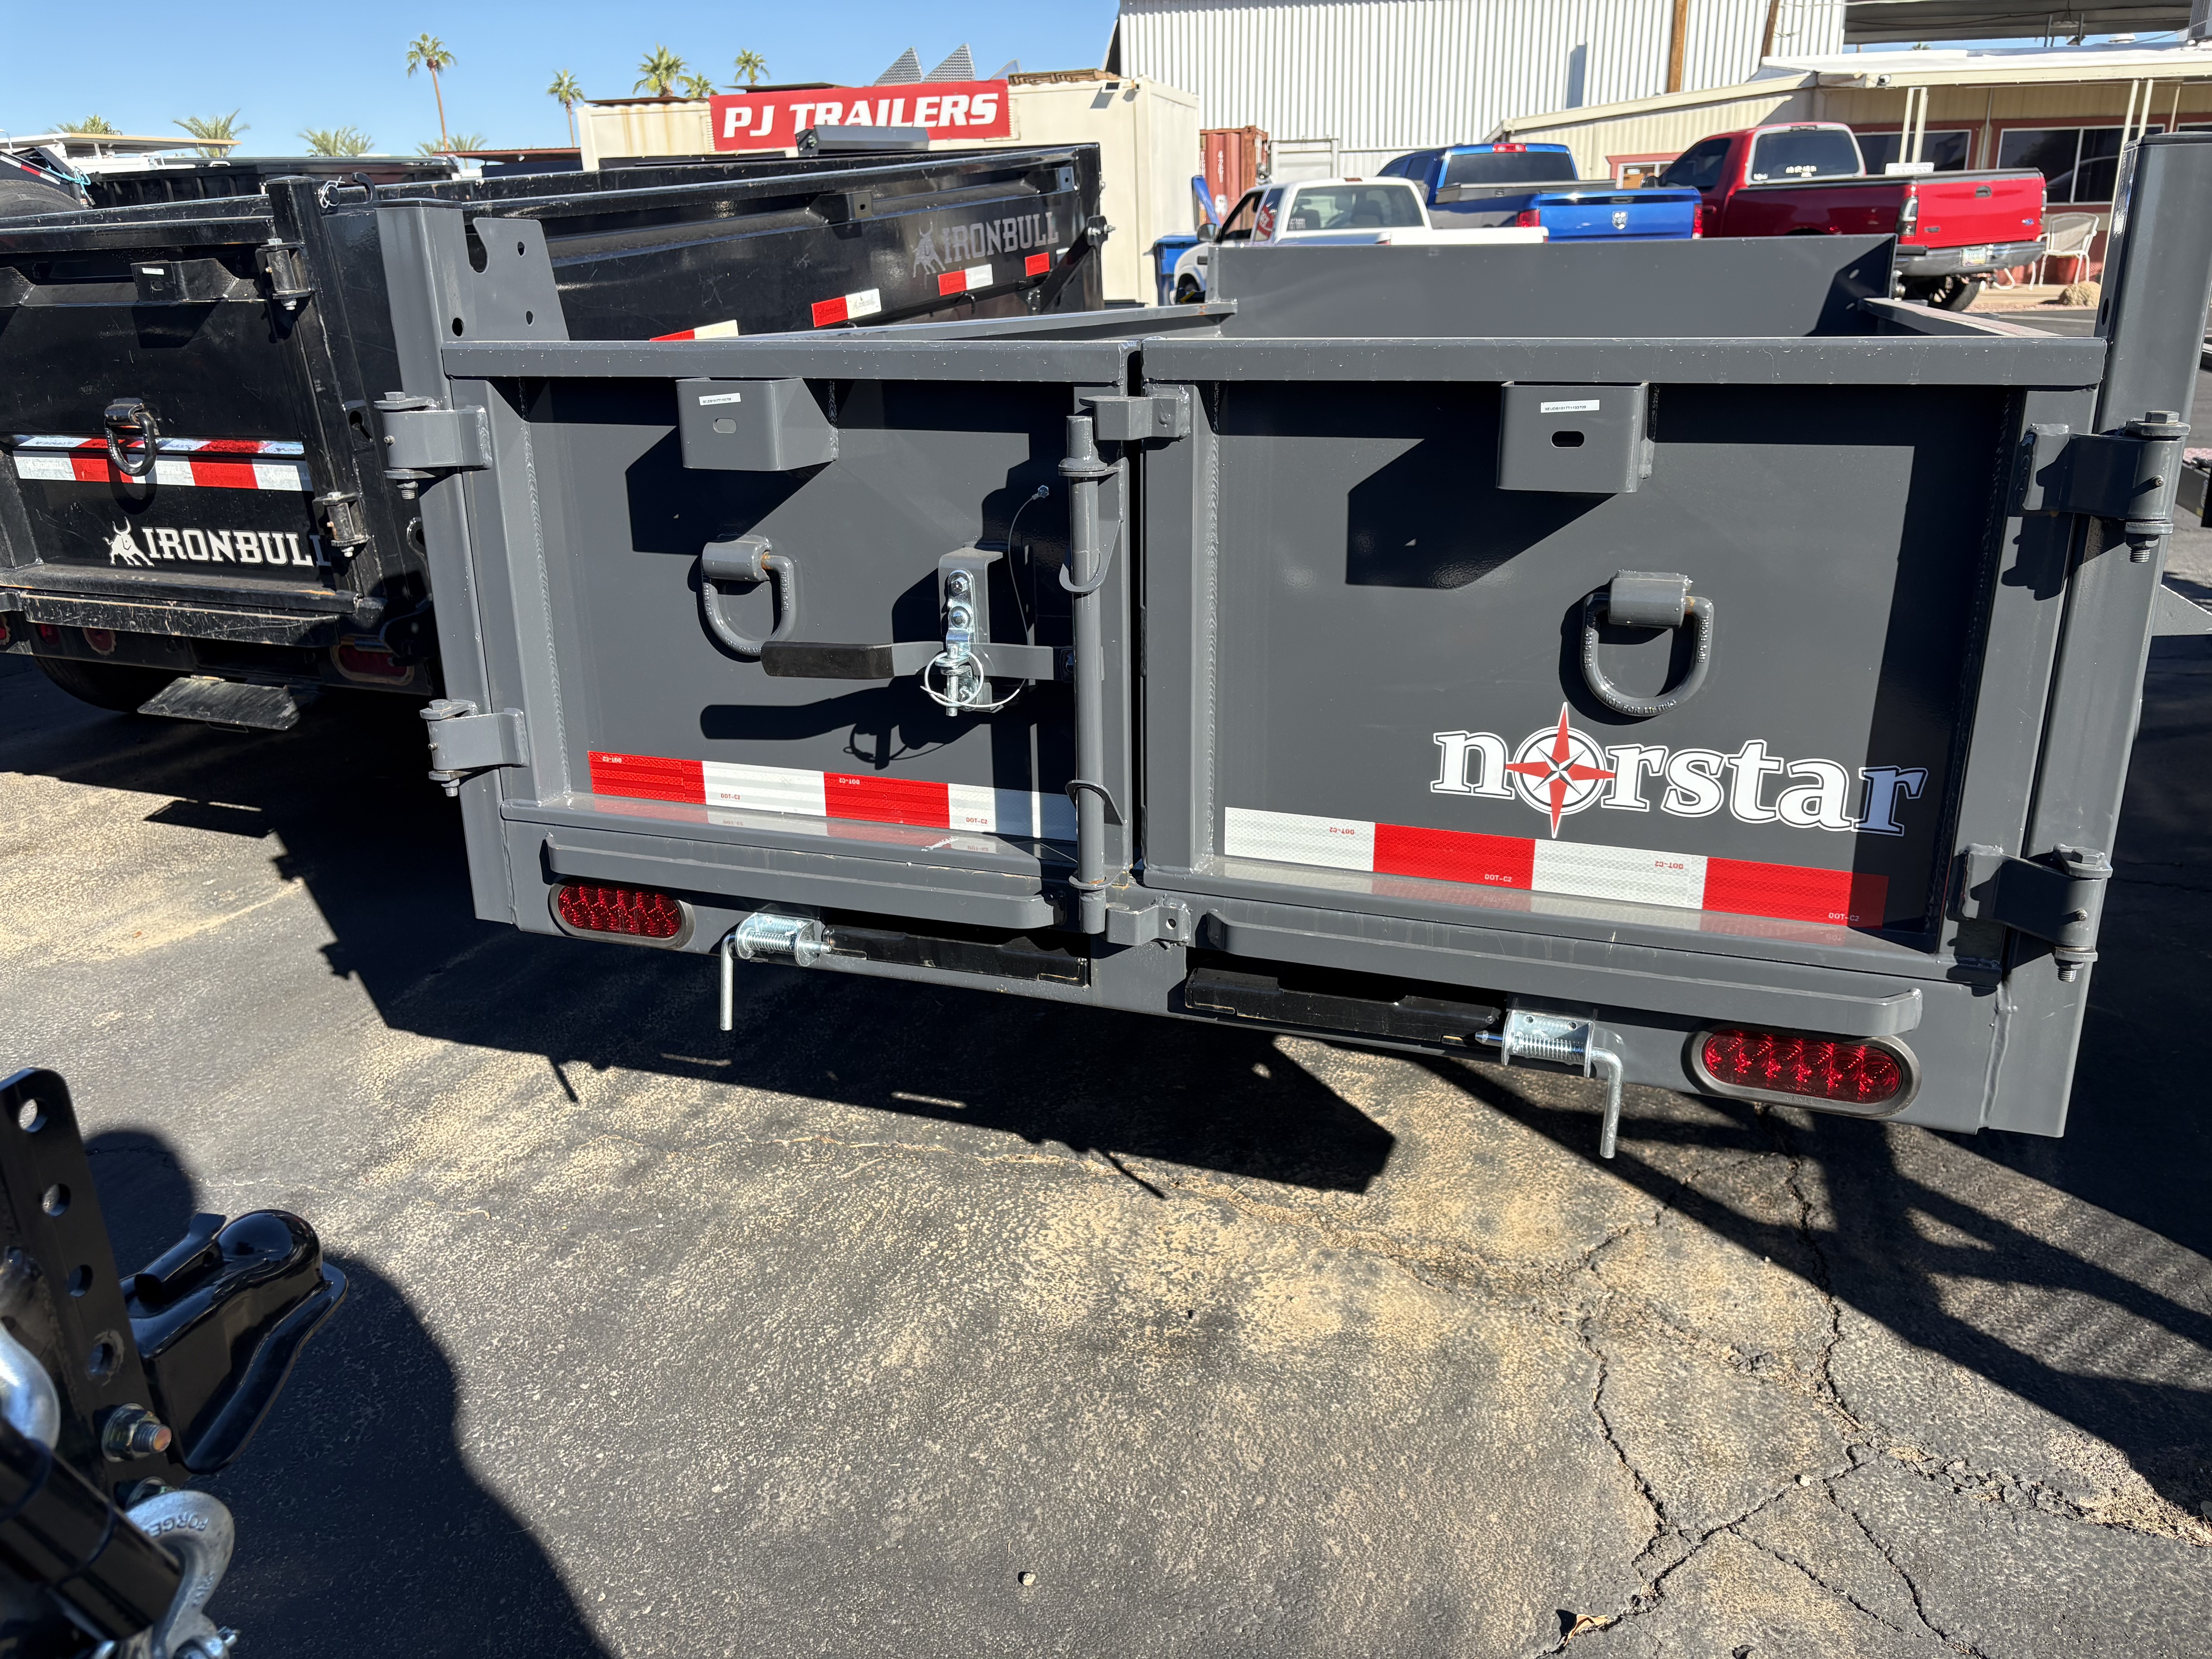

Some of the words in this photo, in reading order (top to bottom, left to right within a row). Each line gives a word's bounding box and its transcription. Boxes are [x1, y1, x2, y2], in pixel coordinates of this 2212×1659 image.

[723, 105, 775, 138] PJ
[789, 93, 999, 134] TRAILERS
[941, 211, 1059, 265] IRONBULL
[141, 526, 332, 567] IRONBULL
[838, 777, 860, 785] DOT-C2
[1431, 723, 1929, 837] norstar
[1329, 826, 1355, 835] DOT-C2
[1654, 860, 1684, 870] DOT-C2
[1484, 873, 1512, 883] DOT-C2
[1828, 912, 1860, 922] DOT-C2
[146, 1511, 209, 1537] FORGE
